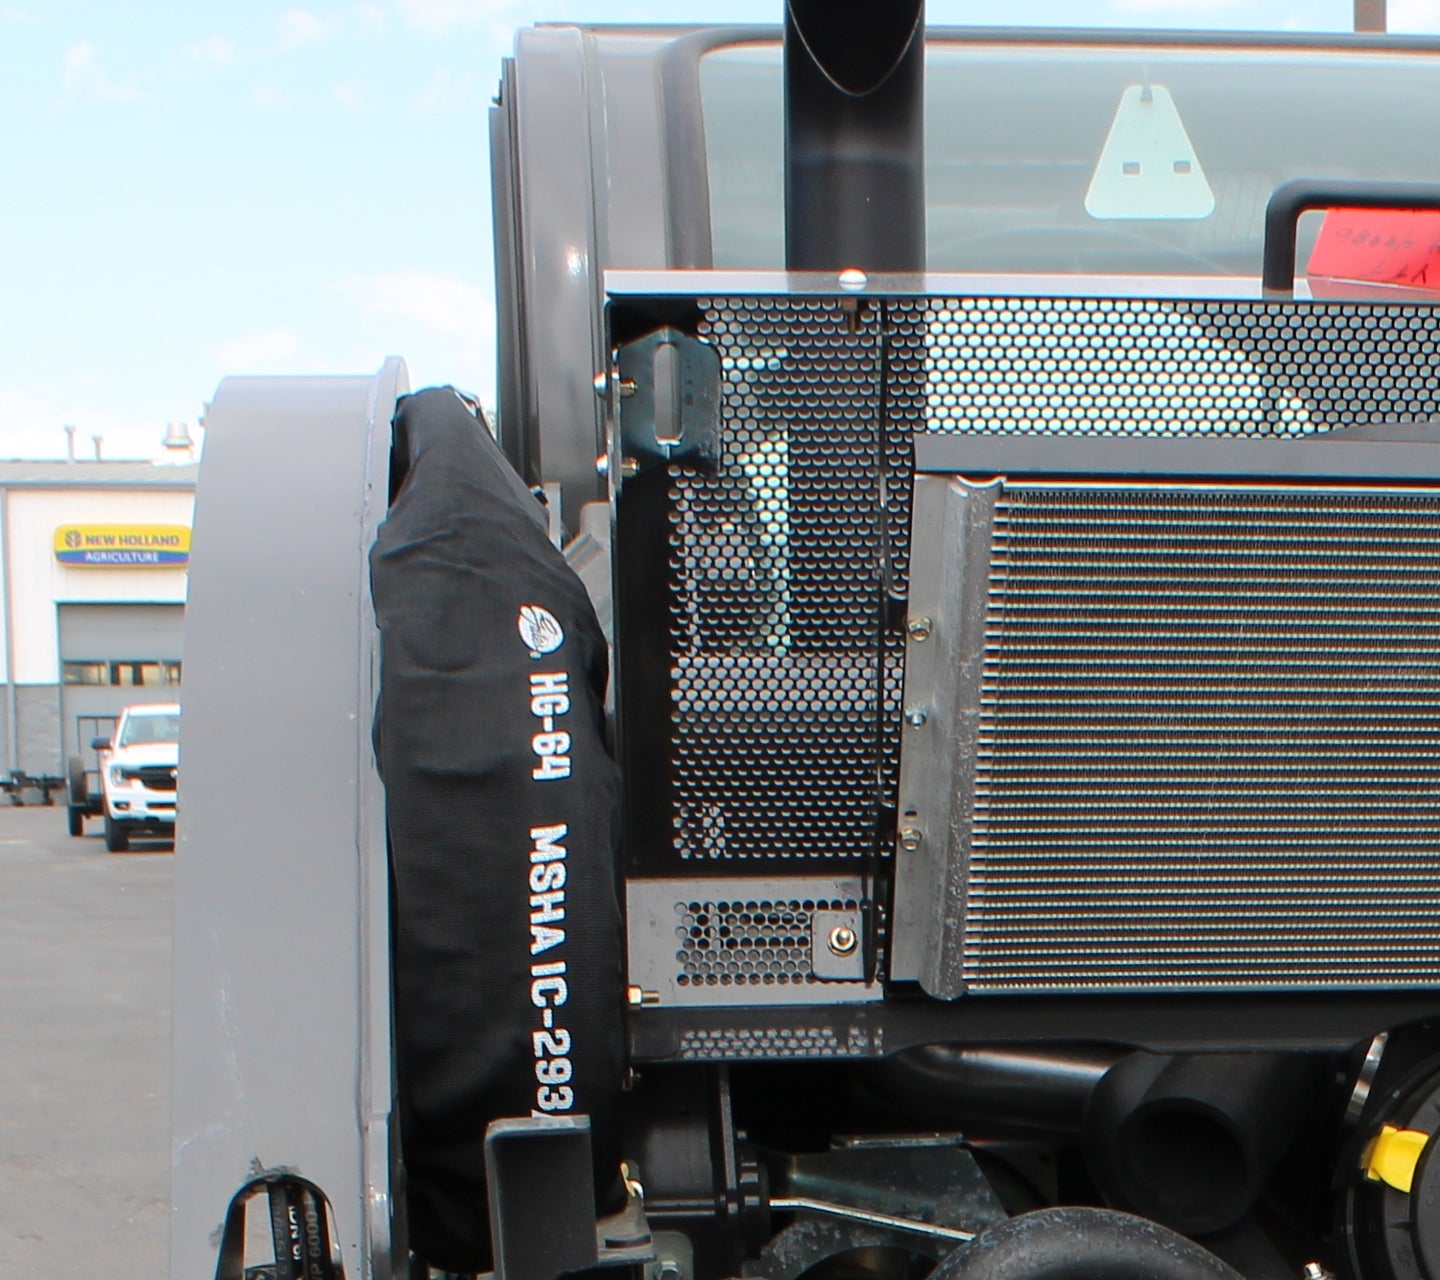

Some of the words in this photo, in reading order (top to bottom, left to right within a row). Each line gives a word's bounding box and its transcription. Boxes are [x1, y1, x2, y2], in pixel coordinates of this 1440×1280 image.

[84, 551, 159, 563] AGRICULTURE
[85, 534, 114, 547] NEW
[119, 533, 180, 546] HOLLAND
[529, 671, 572, 781] HG-64
[529, 823, 567, 955] MSHA
[531, 960, 575, 1119] IC-293
